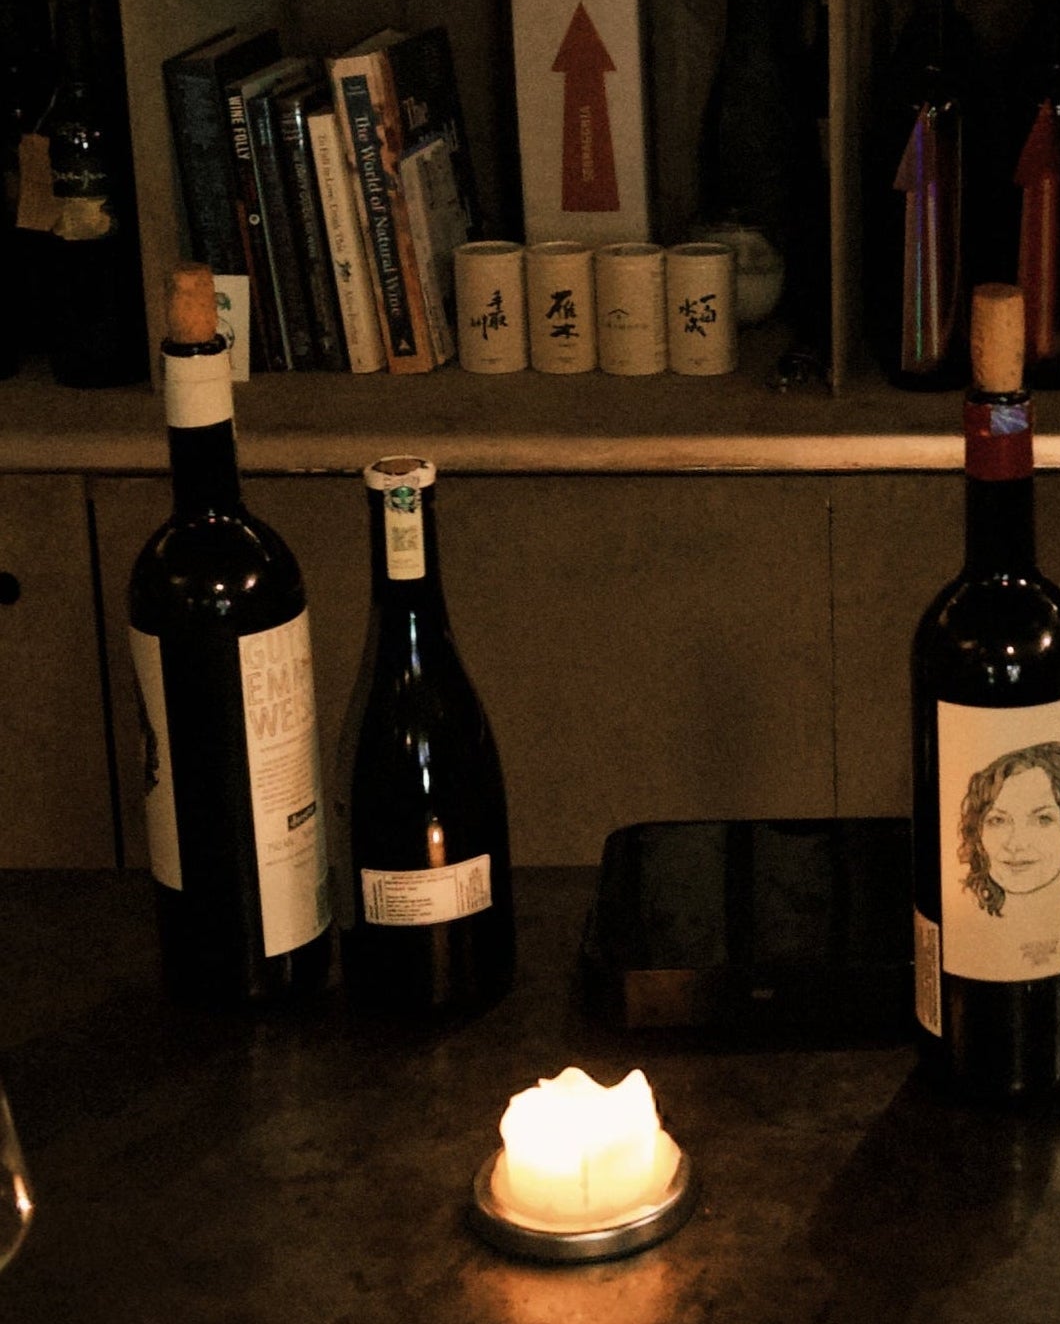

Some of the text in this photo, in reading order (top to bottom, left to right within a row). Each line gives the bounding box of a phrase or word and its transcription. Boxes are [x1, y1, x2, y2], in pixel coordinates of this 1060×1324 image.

[228, 96, 251, 160] WINE FOLLY
[354, 116, 371, 143] The
[360, 145, 384, 192] World
[369, 194, 388, 213] of
[374, 216, 399, 272] Natural
[385, 275, 403, 315] Wine
